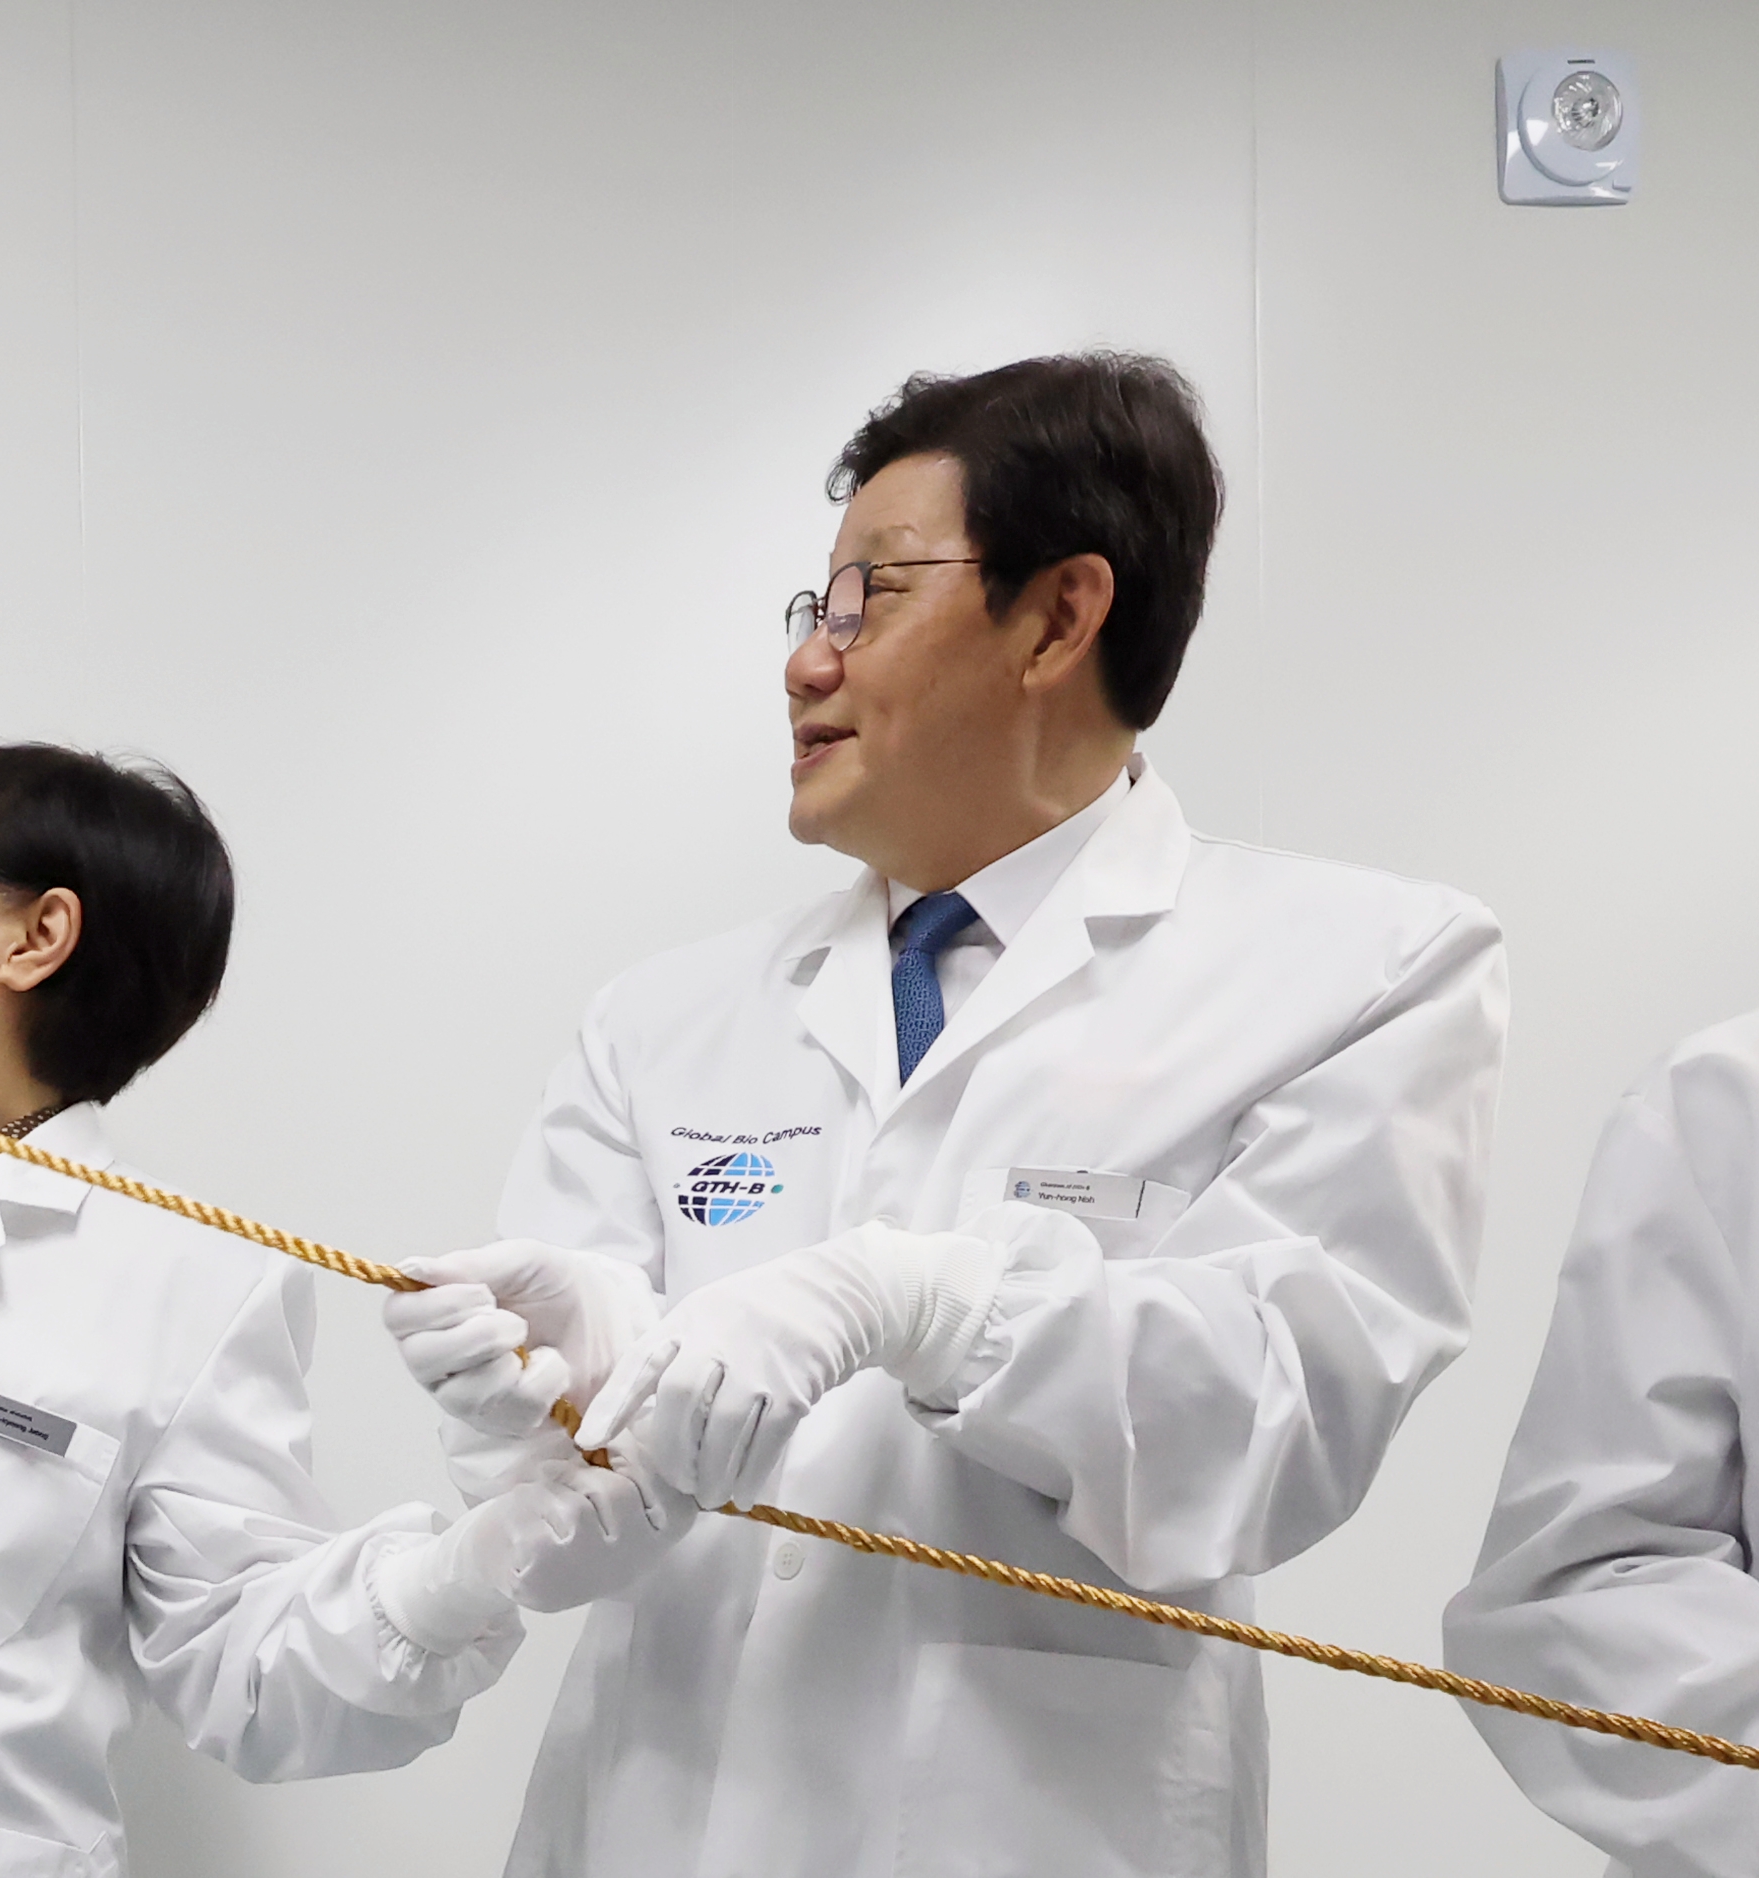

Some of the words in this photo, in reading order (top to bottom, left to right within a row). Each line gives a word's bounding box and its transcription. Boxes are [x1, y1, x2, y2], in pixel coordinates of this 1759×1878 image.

[670, 1127, 731, 1143] Global
[732, 1135, 758, 1145] Bio
[762, 1126, 822, 1144] Campus
[691, 1181, 766, 1194] GTH-B
